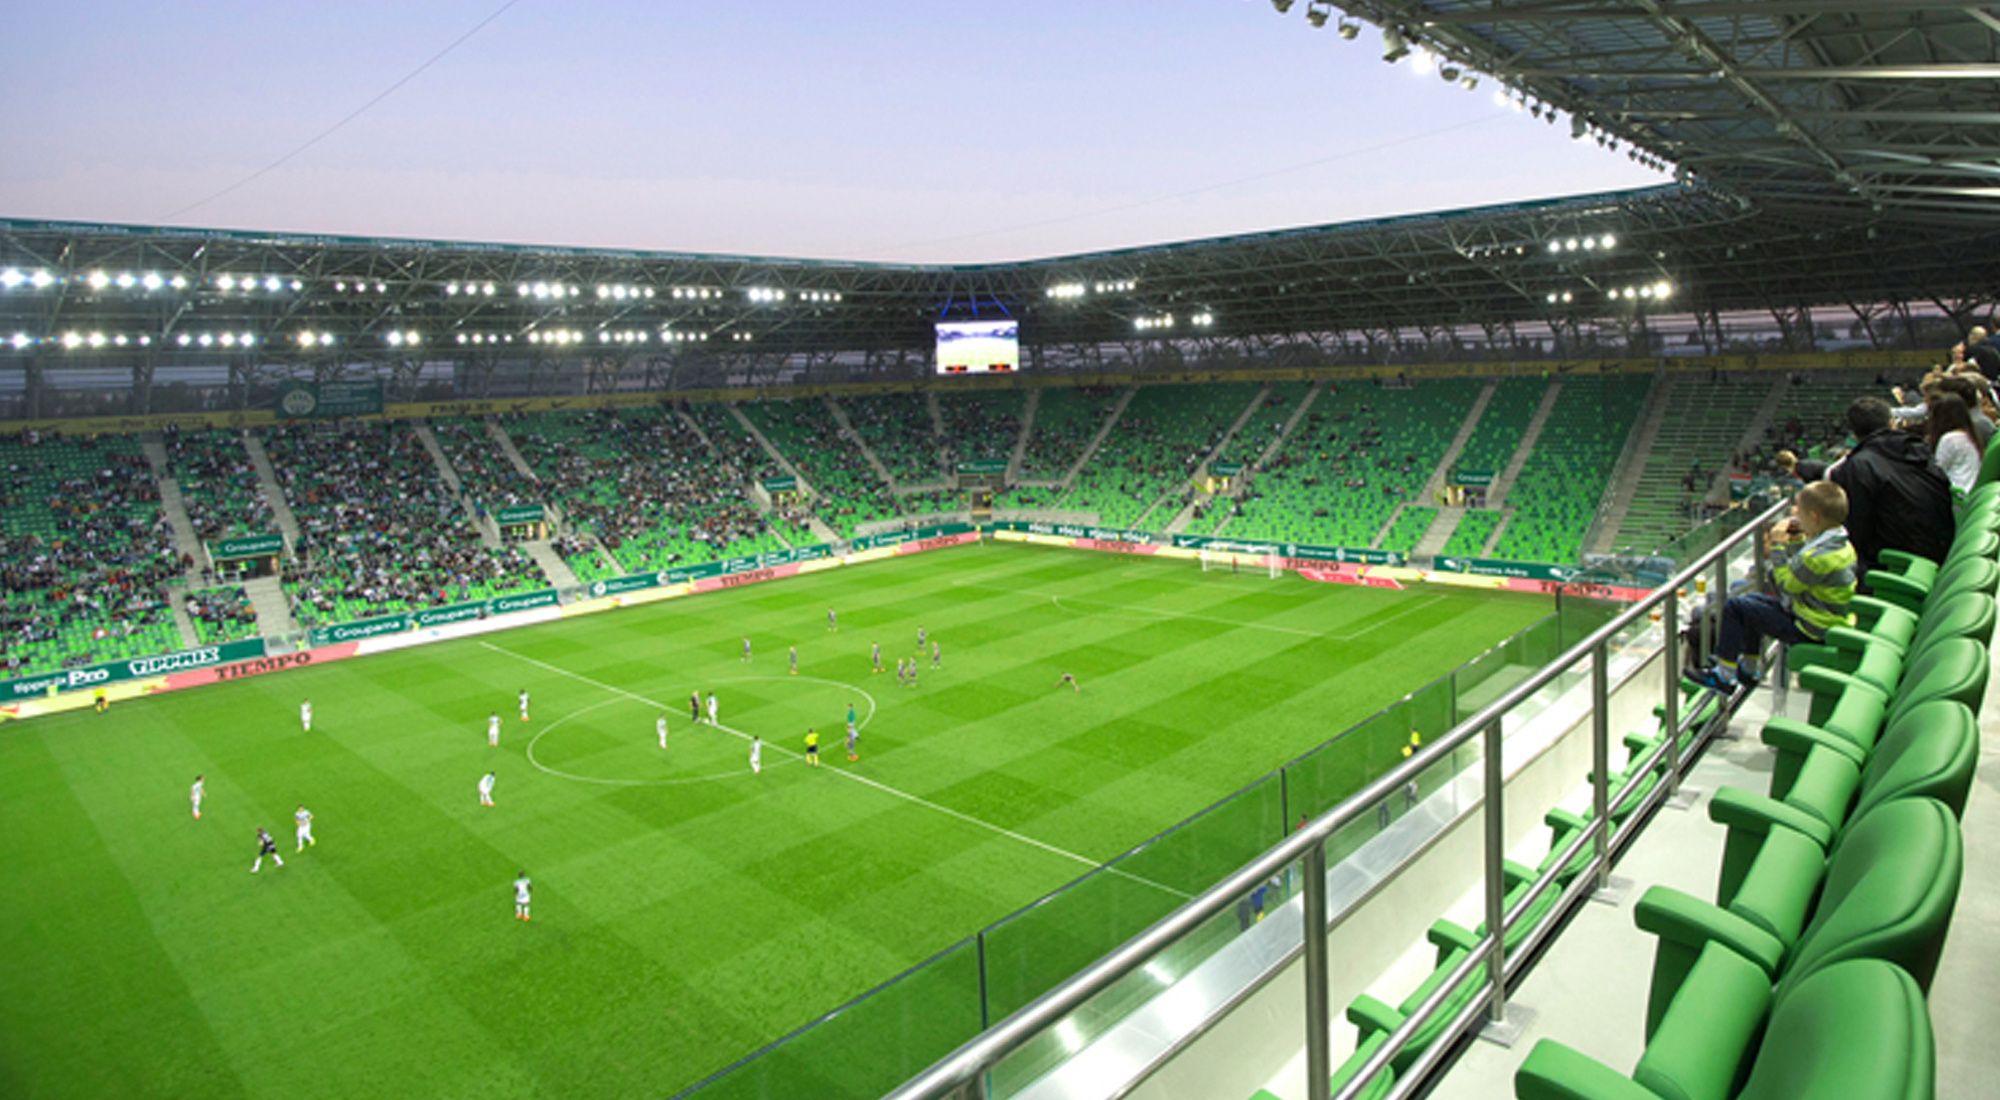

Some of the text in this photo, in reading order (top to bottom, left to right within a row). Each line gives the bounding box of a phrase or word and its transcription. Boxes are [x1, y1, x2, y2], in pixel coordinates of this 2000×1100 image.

[225, 539, 281, 552] Groupama
[499, 594, 553, 612] Groupama
[334, 619, 401, 639] Groupama
[214, 652, 312, 679] TIEMPO
